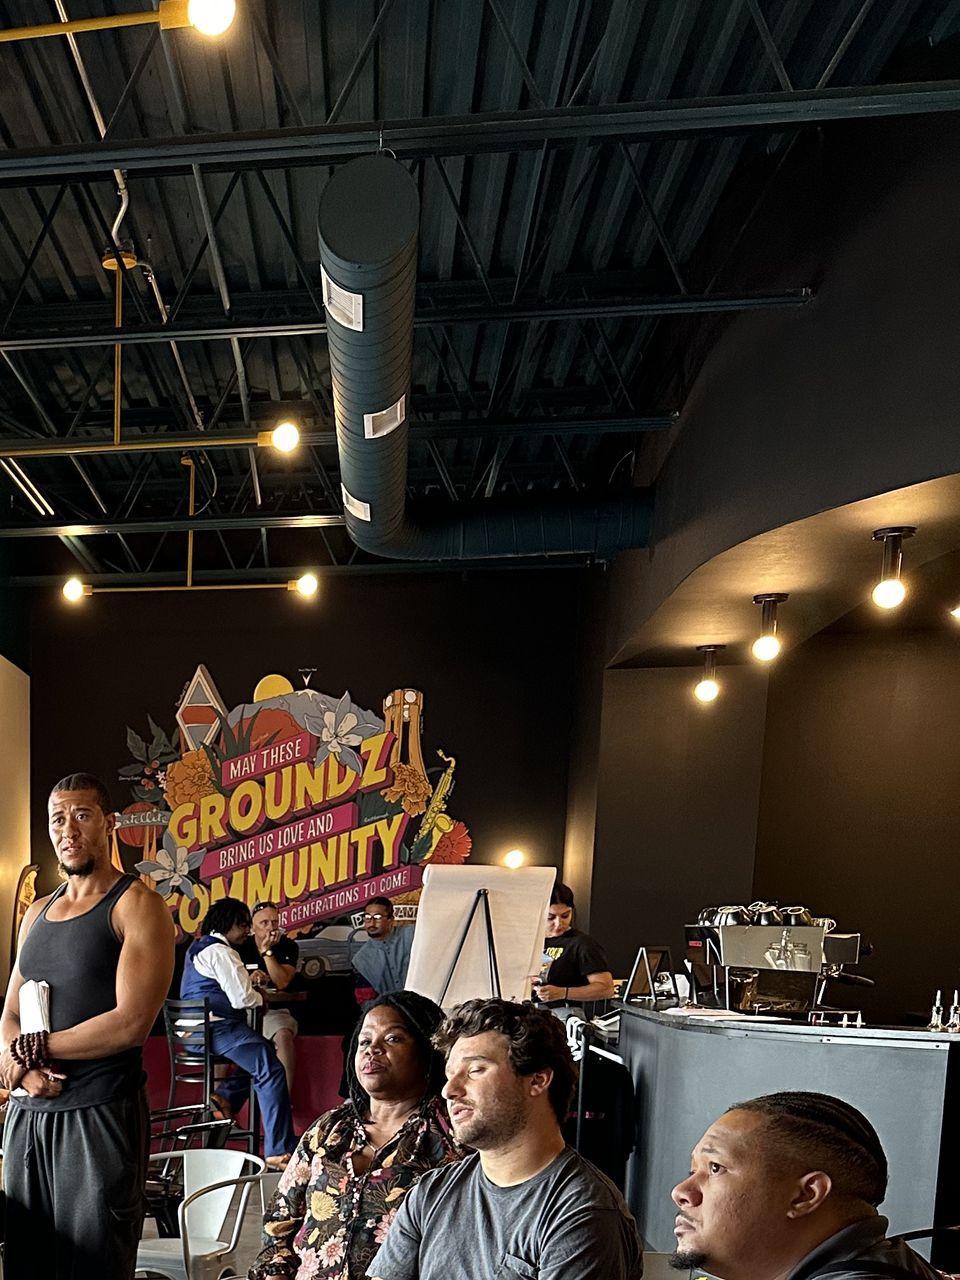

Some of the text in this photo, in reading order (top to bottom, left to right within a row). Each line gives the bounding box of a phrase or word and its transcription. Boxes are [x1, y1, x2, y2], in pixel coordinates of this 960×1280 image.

[229, 759, 257, 781] MAY
[261, 738, 302, 769] THESE
[168, 731, 390, 848] GROUNDZ
[219, 813, 333, 870] BRING US LOVE AND
[291, 888, 359, 923] GENERATIONS
[363, 881, 377, 898] TO
[379, 870, 408, 892] COME
